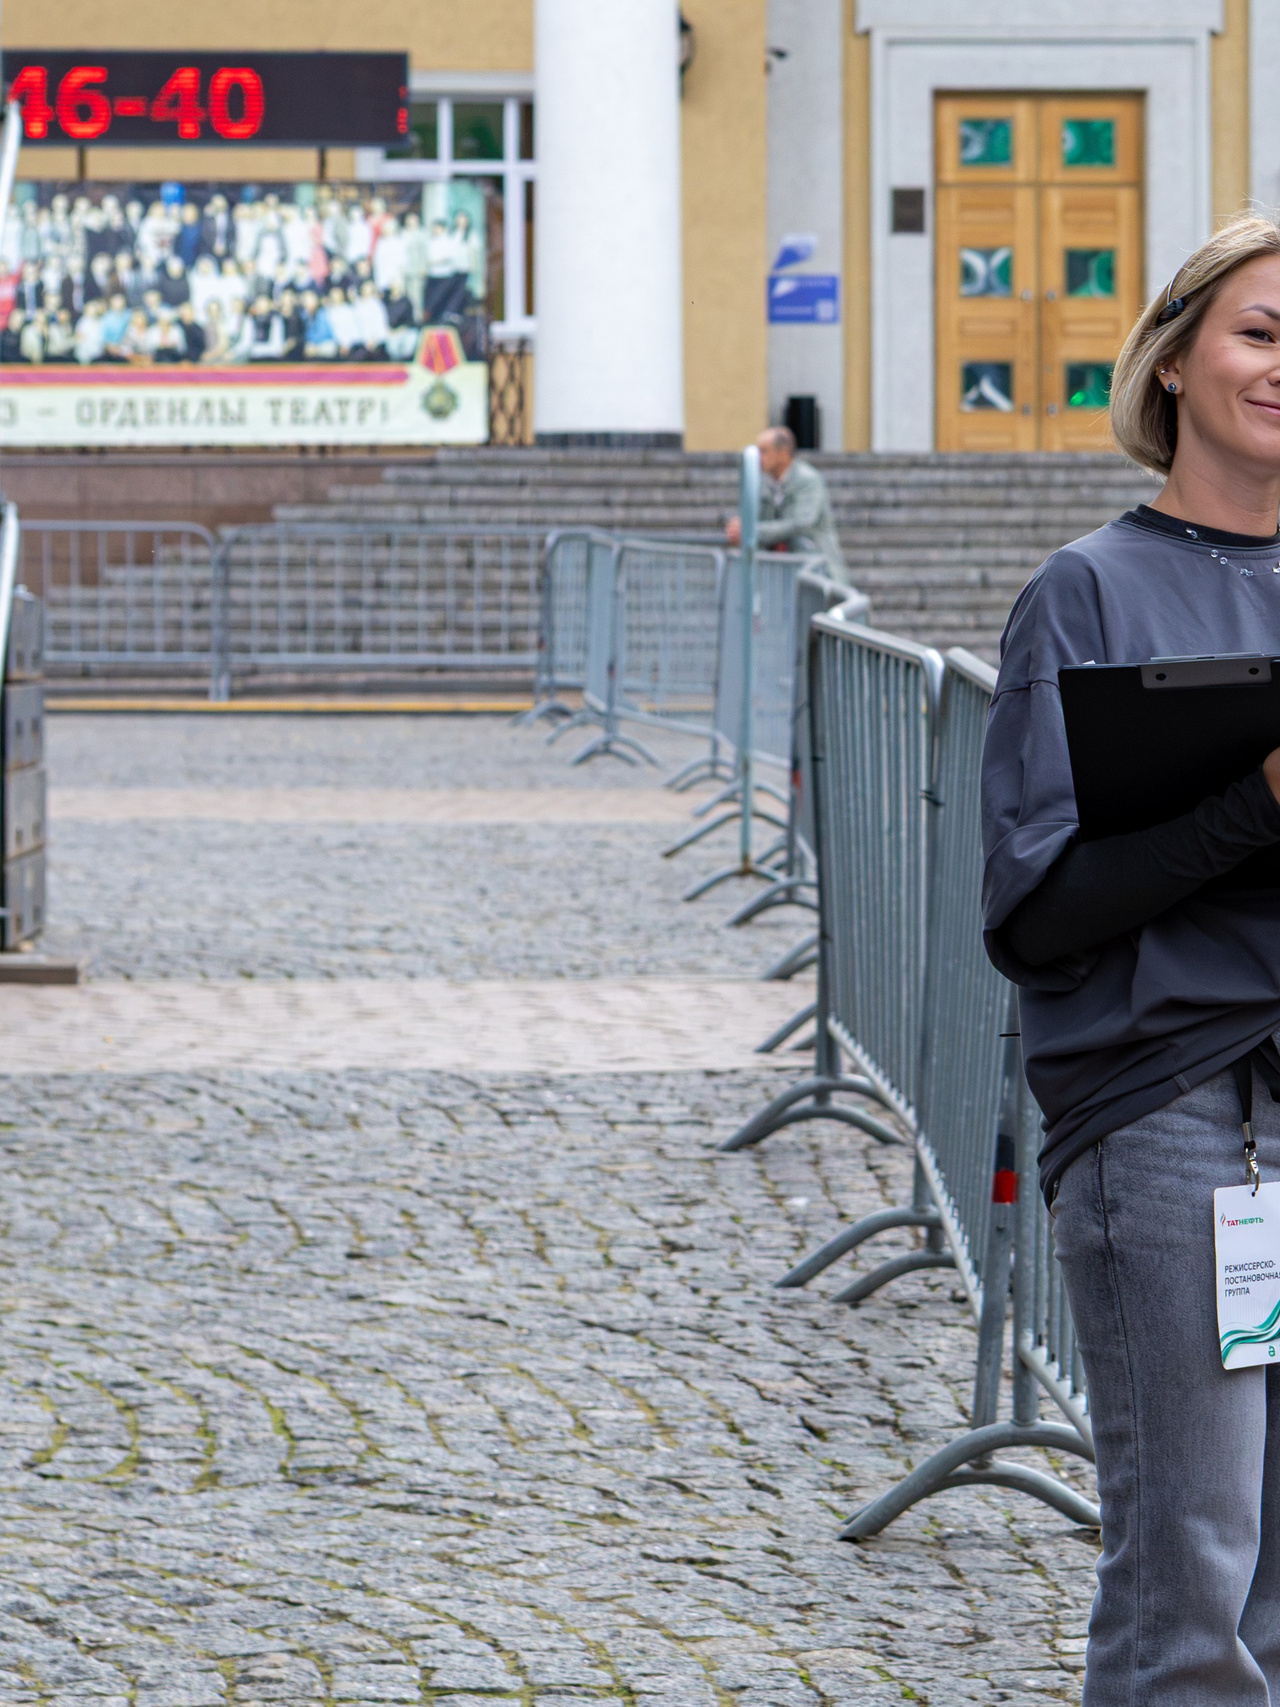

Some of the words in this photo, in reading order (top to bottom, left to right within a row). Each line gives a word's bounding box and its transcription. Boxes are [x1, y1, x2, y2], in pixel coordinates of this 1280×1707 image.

[10, 66, 264, 139] 46-40
[1226, 1217, 1264, 1227] ТАТНЕФТЬ
[1224, 1260, 1276, 1273] РЕЖИССЕРСКО-
[1224, 1287, 1251, 1298] ГРУППА
